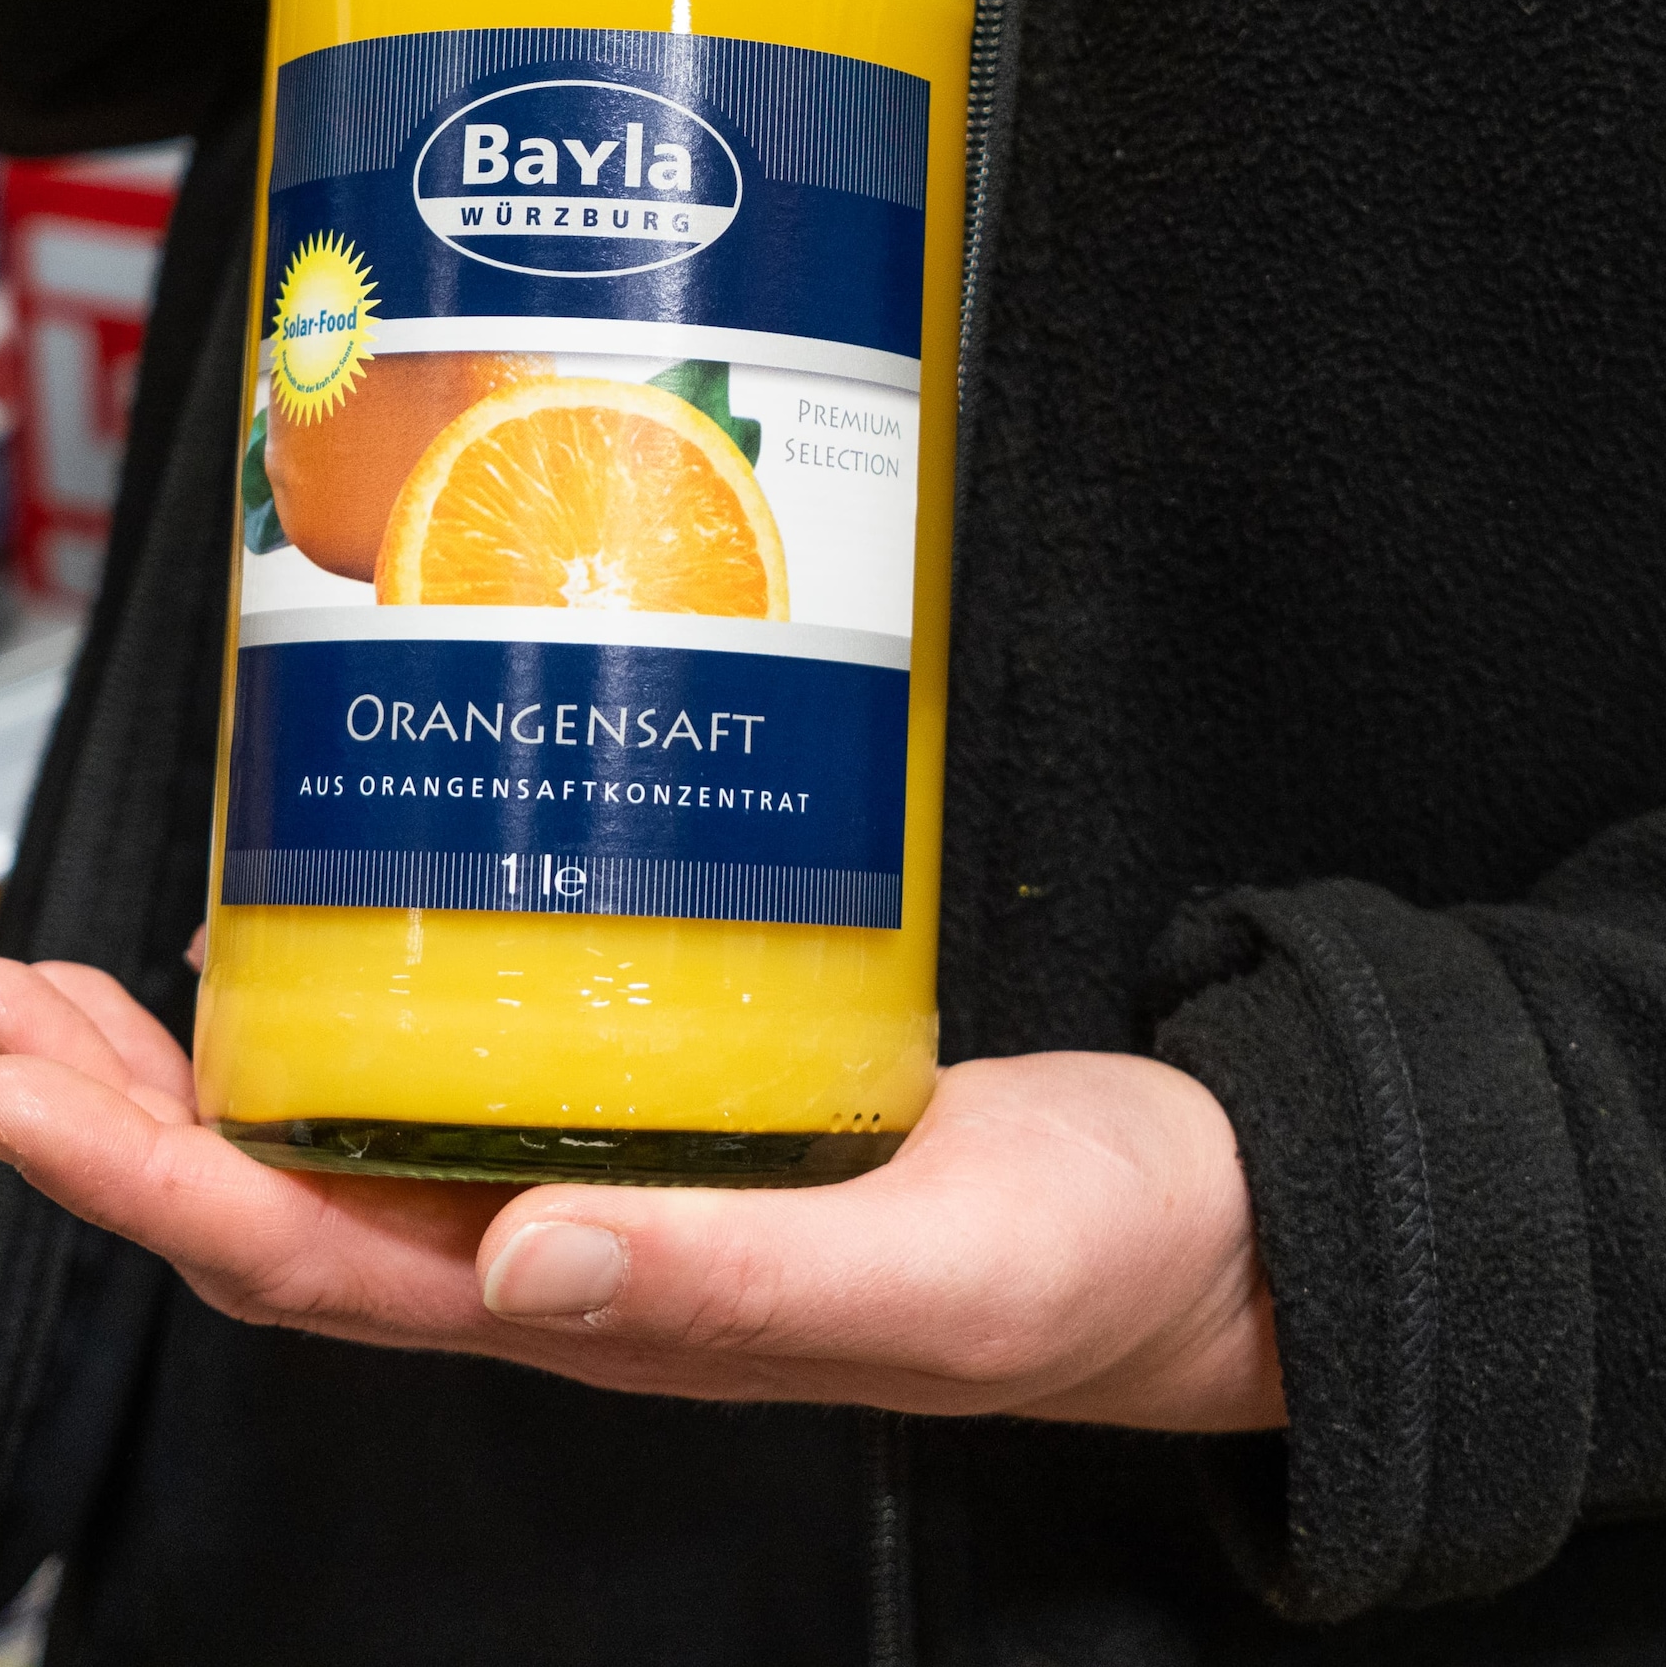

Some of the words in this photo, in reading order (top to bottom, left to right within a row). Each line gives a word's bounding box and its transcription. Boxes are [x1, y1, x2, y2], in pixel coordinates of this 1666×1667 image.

[462, 122, 692, 192] Bayla
[461, 202, 690, 234] WÜRZBURG
[798, 398, 901, 440] PREMIUM
[785, 437, 899, 478] SELECTION
[346, 693, 766, 754] ORANGENSAFT
[299, 774, 345, 797] AUS
[359, 774, 810, 814] ORANGENSAFTKONZENTRAT
